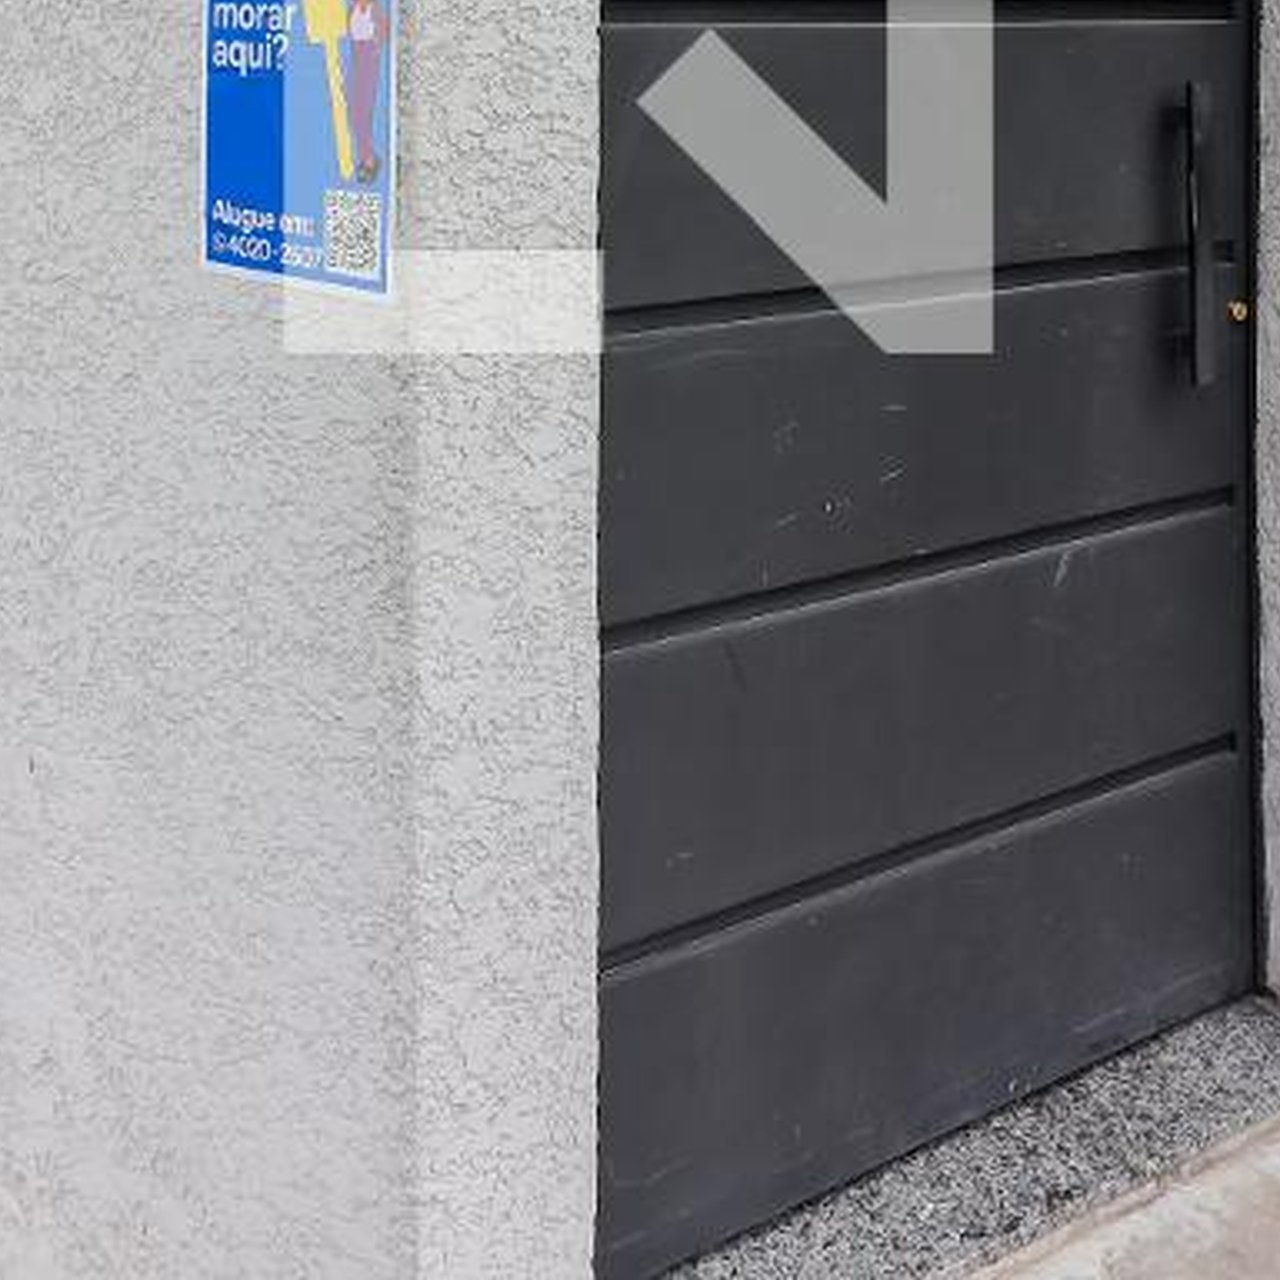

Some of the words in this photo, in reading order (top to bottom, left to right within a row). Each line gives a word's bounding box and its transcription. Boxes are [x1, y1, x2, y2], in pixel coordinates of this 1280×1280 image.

[213, 1, 297, 32] morar
[213, 33, 290, 77] aqui?
[211, 200, 276, 234] Alugue
